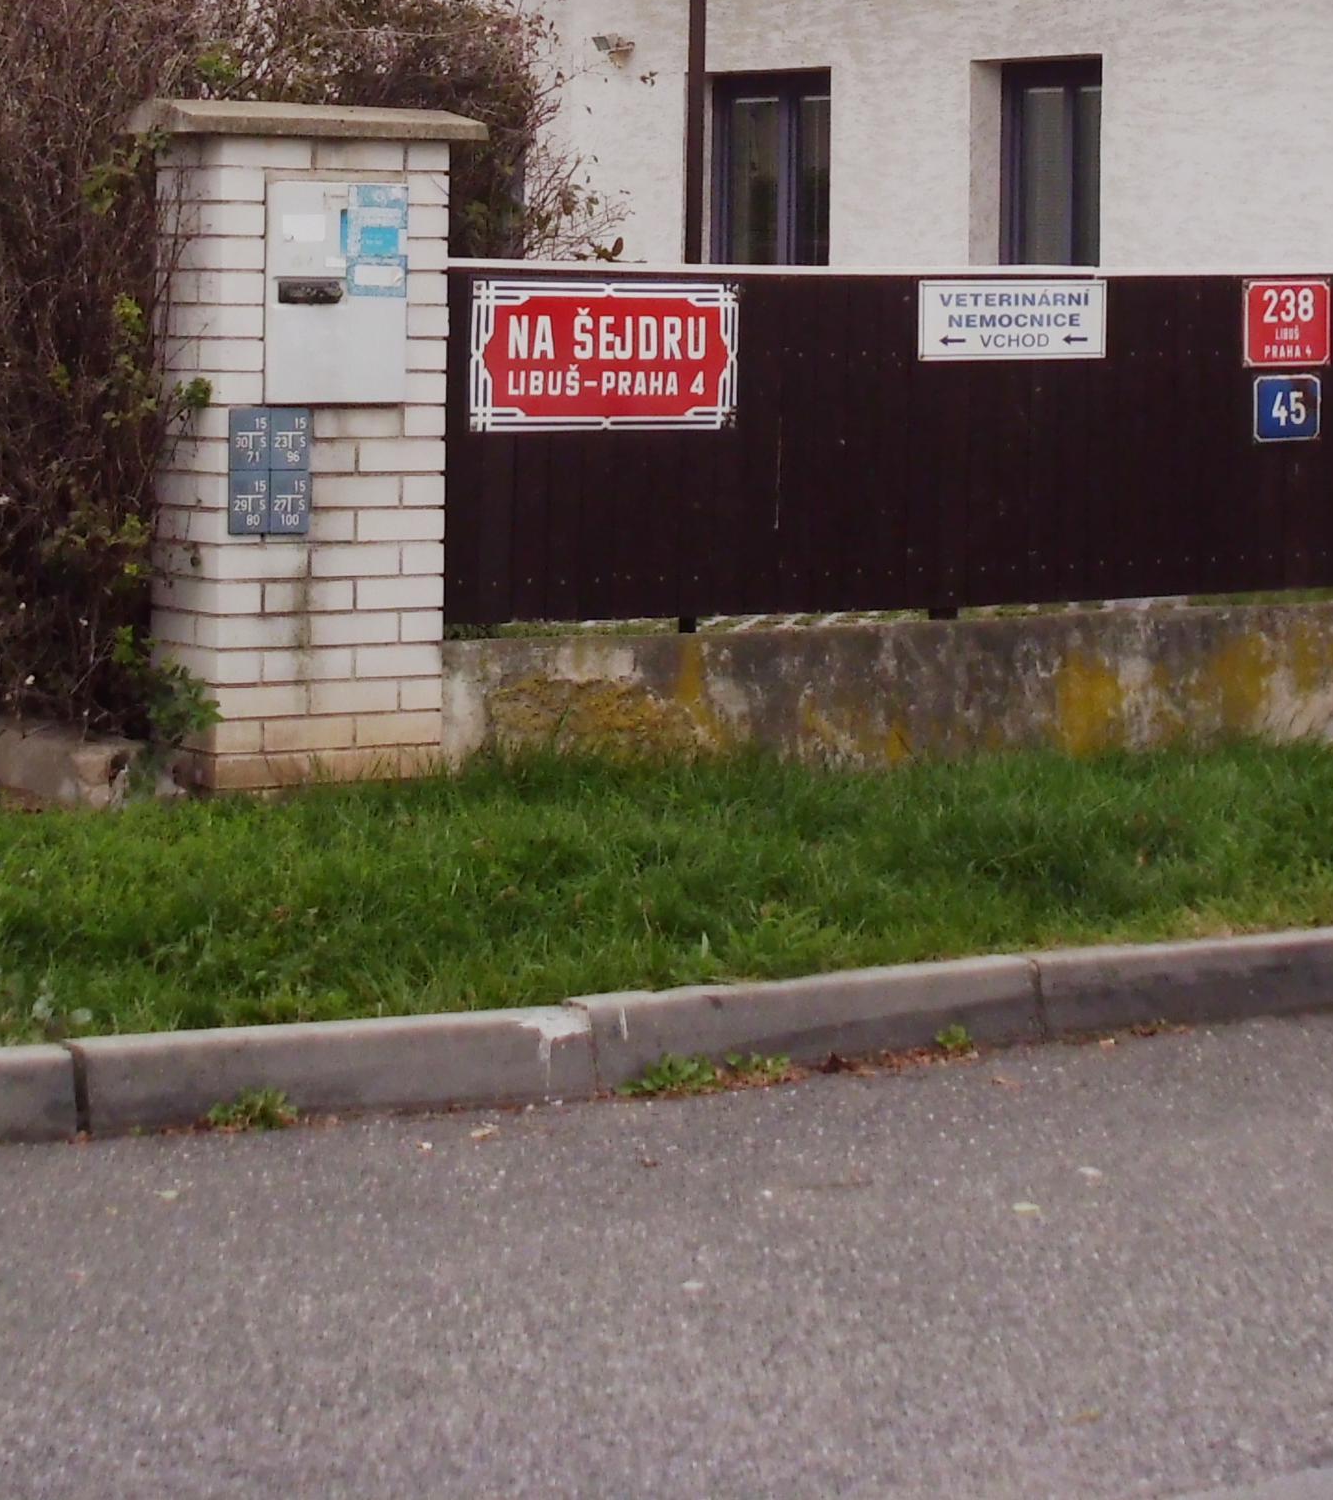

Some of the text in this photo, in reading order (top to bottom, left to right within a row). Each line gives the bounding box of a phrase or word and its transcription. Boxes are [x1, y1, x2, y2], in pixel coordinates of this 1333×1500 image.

[938, 288, 1091, 308] VETERINÁRNÍ
[1262, 287, 1315, 324] 238
[947, 312, 1081, 329] NEMOCNICE
[507, 306, 707, 361] NA ŠEJDRU
[1274, 324, 1300, 341] LIBUŠ
[979, 333, 1050, 349] VCHOD
[1263, 344, 1312, 359] PRAHA 4
[689, 370, 706, 396] 4
[1271, 390, 1307, 427] 45
[255, 417, 267, 430] 15
[294, 417, 307, 430] 15
[255, 480, 267, 492] 15
[294, 480, 306, 492] 15
[246, 514, 260, 526] 80
[281, 514, 300, 526] 100
